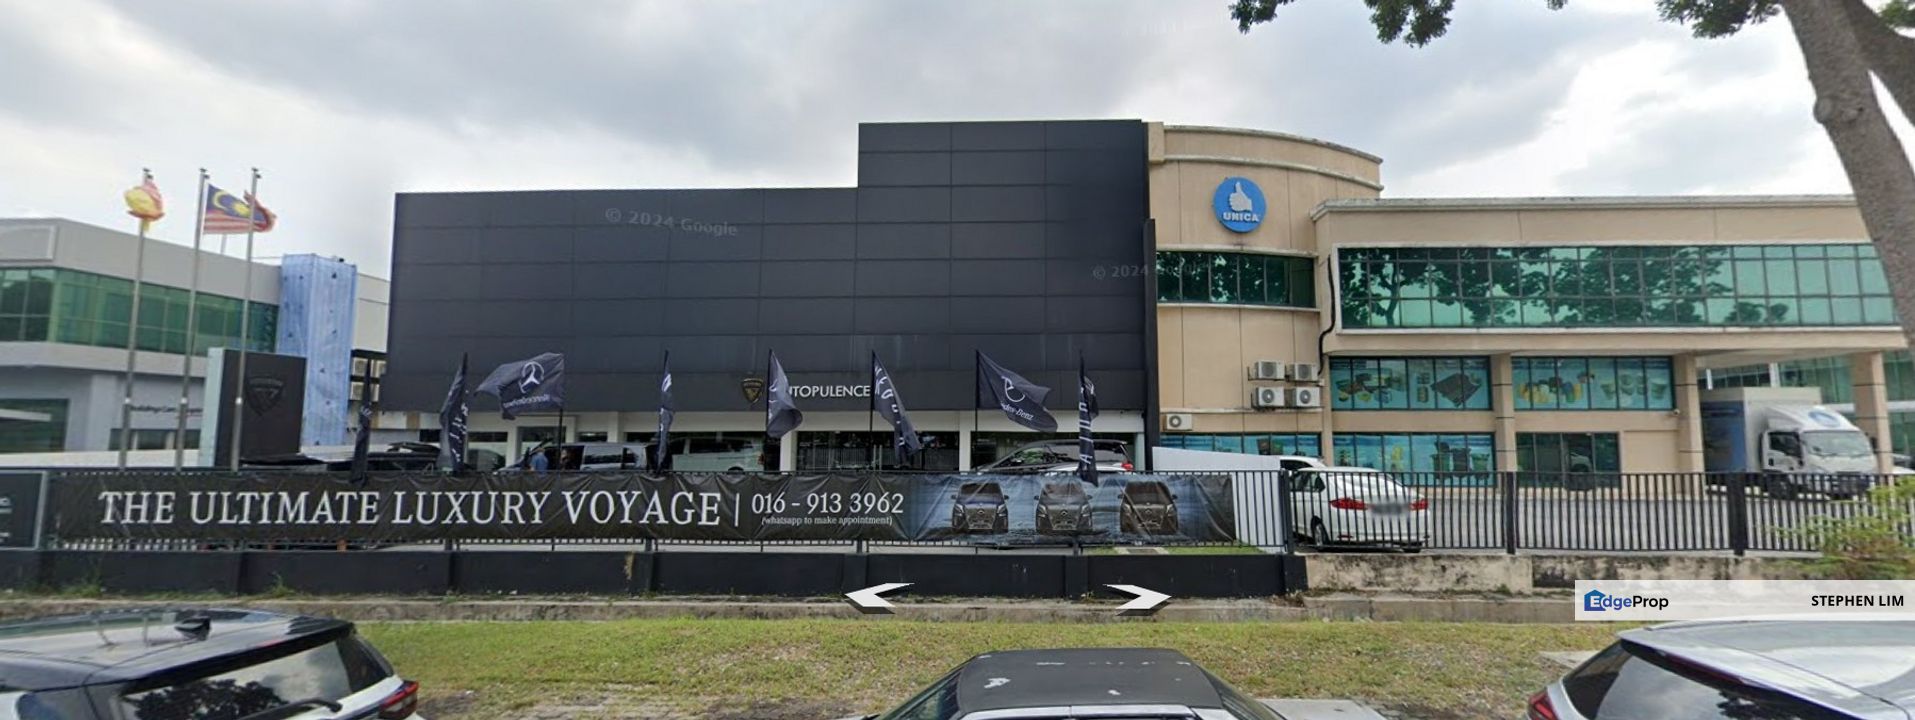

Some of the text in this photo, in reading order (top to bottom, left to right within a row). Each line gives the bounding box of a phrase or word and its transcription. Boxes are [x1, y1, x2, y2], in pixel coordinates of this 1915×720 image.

[1223, 211, 1259, 222] UNICA
[789, 385, 871, 398] TOPULENCE
[98, 491, 176, 524] THE
[189, 490, 380, 524] ULTIMATE
[391, 490, 549, 525] LUXURY
[561, 490, 720, 526] VOYAGE
[751, 492, 786, 514] 016
[807, 492, 842, 515] 913
[849, 492, 904, 515] 3962
[761, 516, 893, 526] (whatsapp to make appointment)
